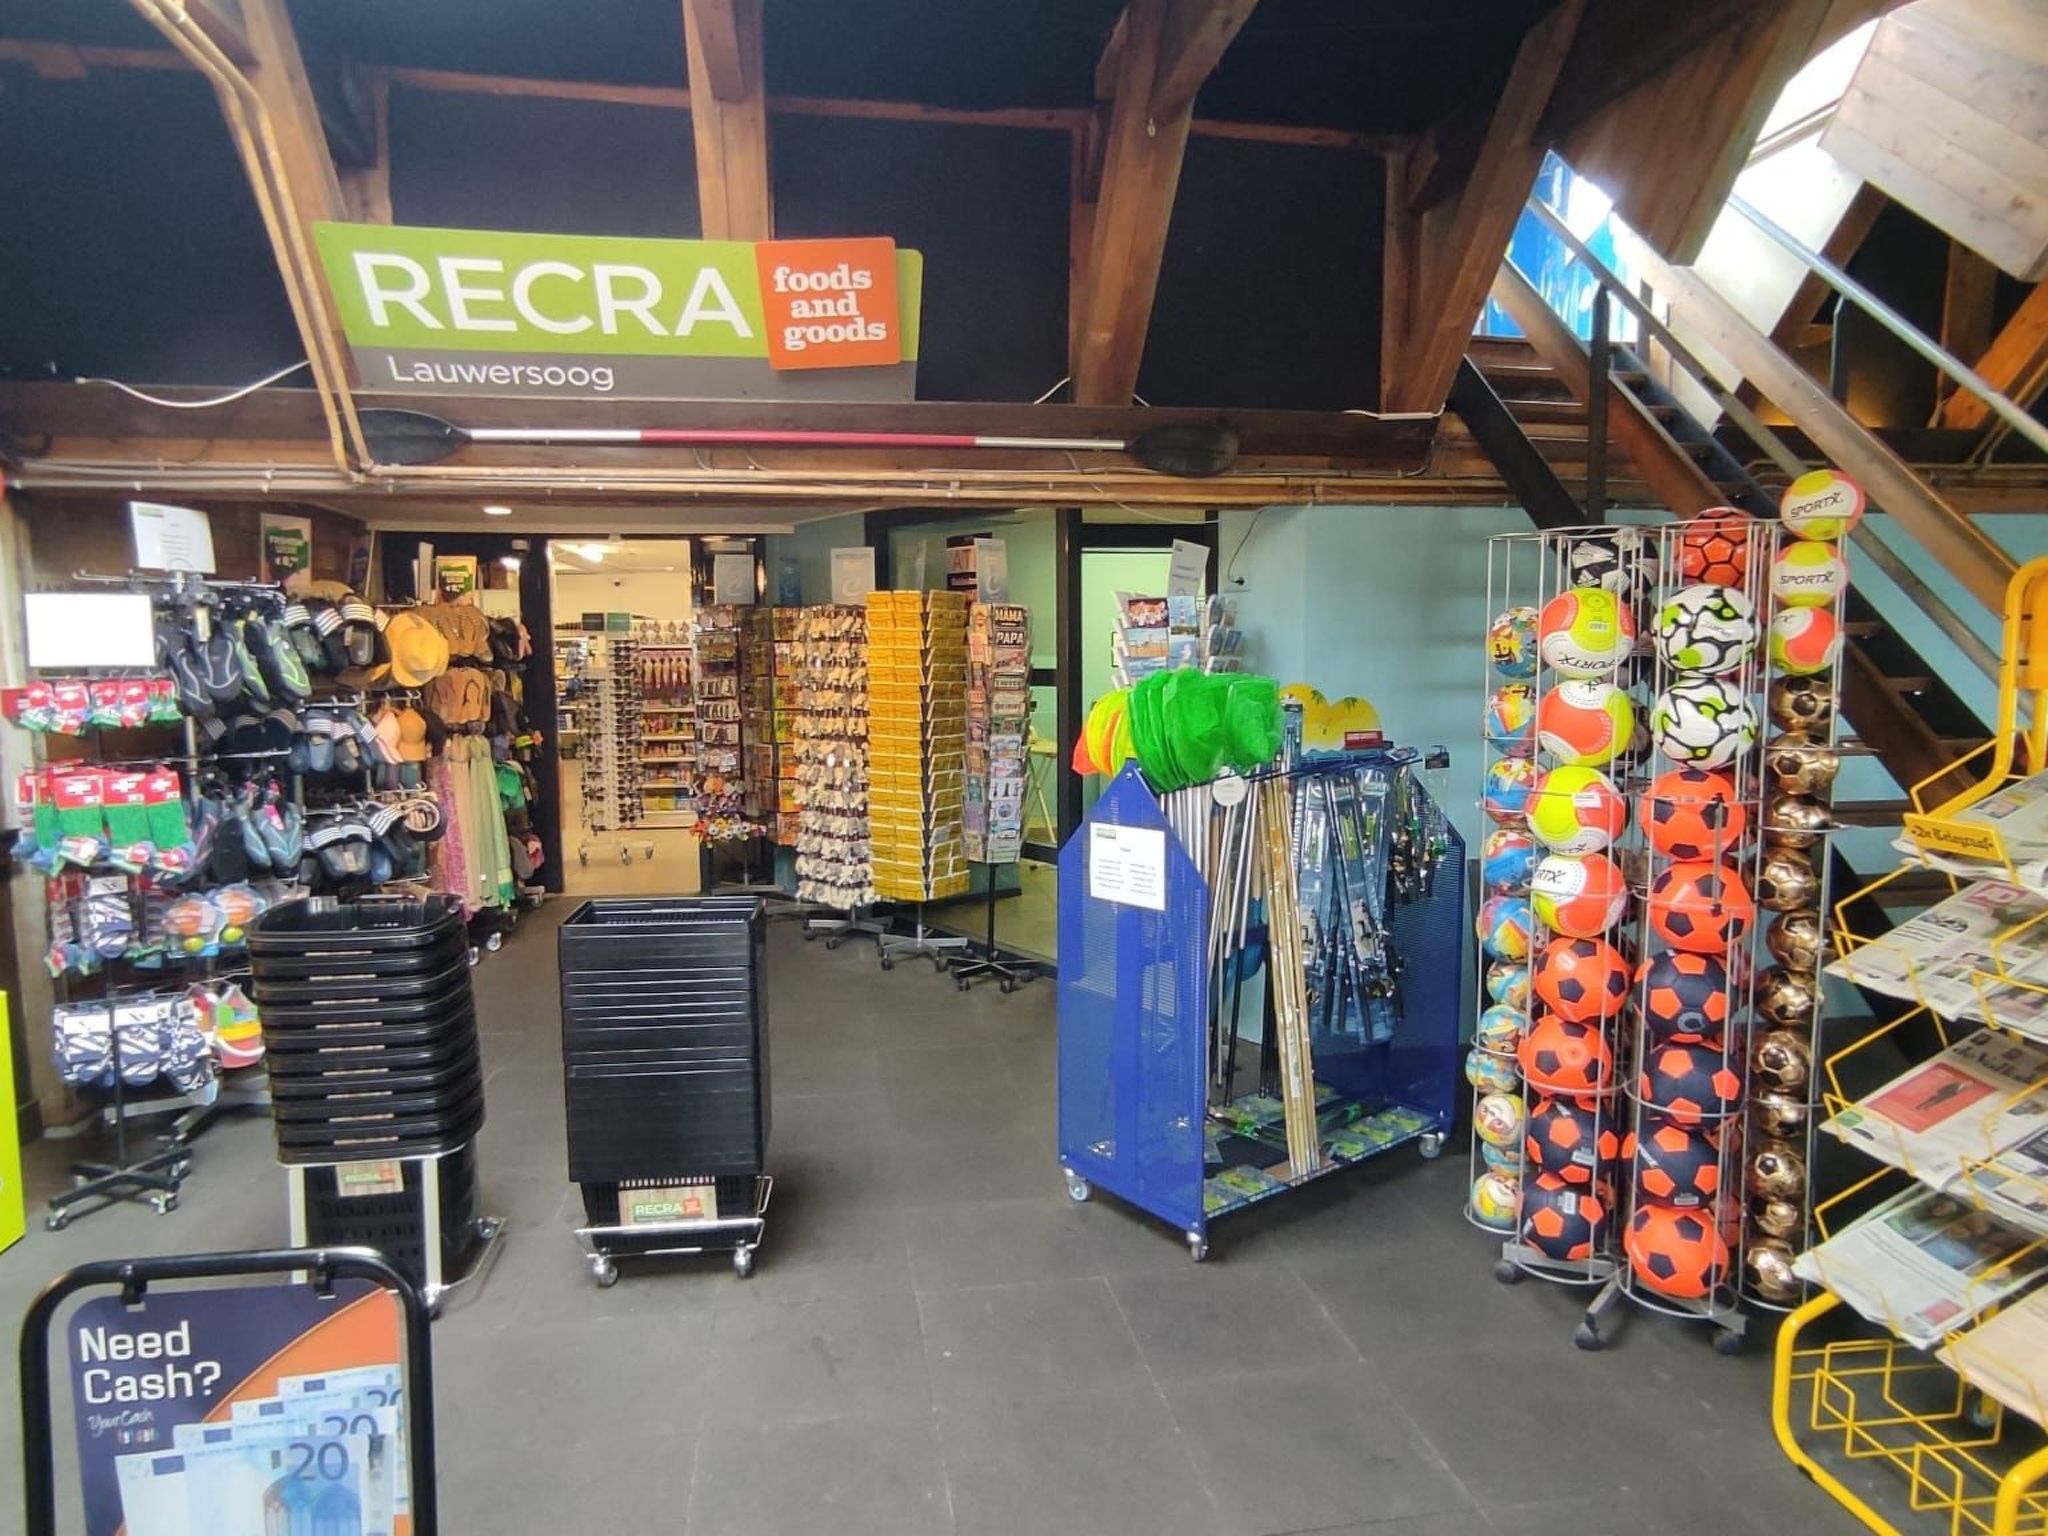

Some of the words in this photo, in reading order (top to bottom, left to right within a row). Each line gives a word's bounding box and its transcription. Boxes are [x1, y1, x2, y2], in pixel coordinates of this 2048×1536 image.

[772, 263, 873, 294] foods
[352, 251, 754, 339] RECRA
[789, 292, 861, 318] and
[783, 319, 888, 352] goods
[387, 354, 615, 393] Lauwersoog
[1790, 490, 1842, 518] SPORTX
[1780, 570, 1835, 585] SPORTX
[994, 608, 1024, 622] MAMA
[995, 631, 1025, 645] PAPA
[635, 1203, 682, 1216] RECRA
[79, 1319, 191, 1364] Need
[83, 1360, 222, 1405] Cash?
[287, 1440, 350, 1482] 20
